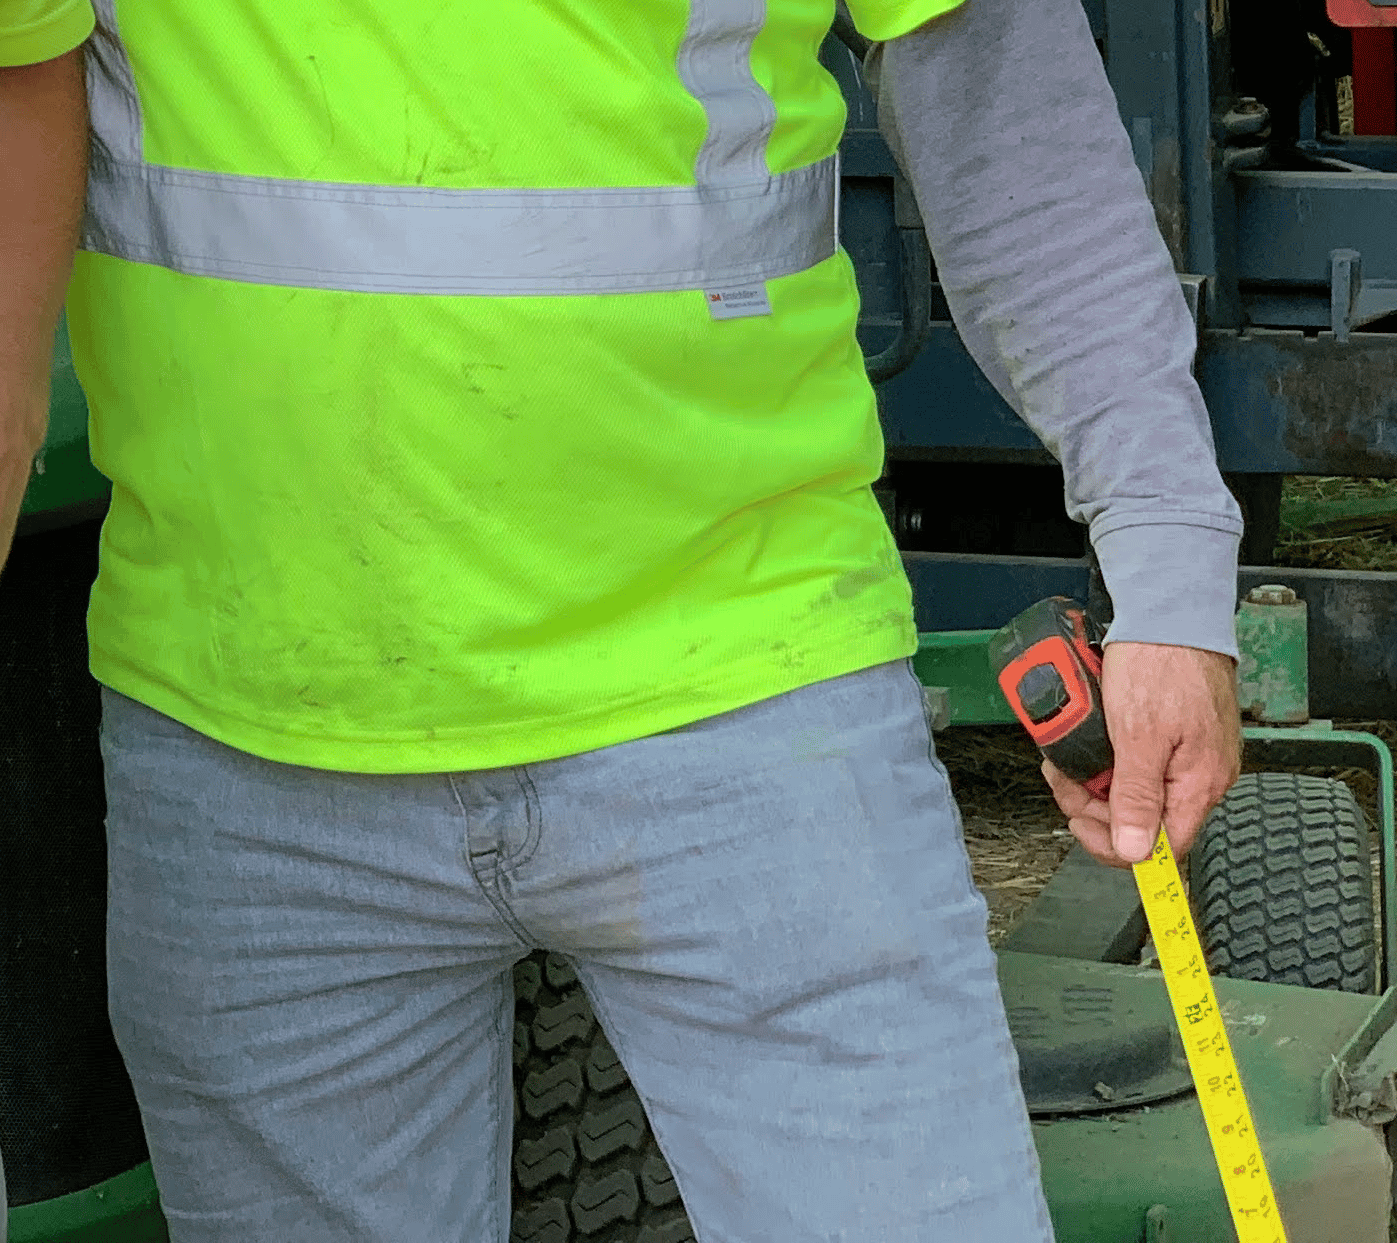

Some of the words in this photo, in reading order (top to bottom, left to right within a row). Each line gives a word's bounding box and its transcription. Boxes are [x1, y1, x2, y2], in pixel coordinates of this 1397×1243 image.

[1155, 841, 1168, 865] 28
[1166, 881, 1179, 902] 27
[1178, 916, 1190, 940] 26
[1188, 955, 1201, 979] 25
[1200, 992, 1213, 1017] 24
[1211, 1032, 1225, 1057] 23
[1207, 1076, 1222, 1092] 10
[1223, 1072, 1236, 1097] 22
[1247, 1153, 1260, 1179] 20
